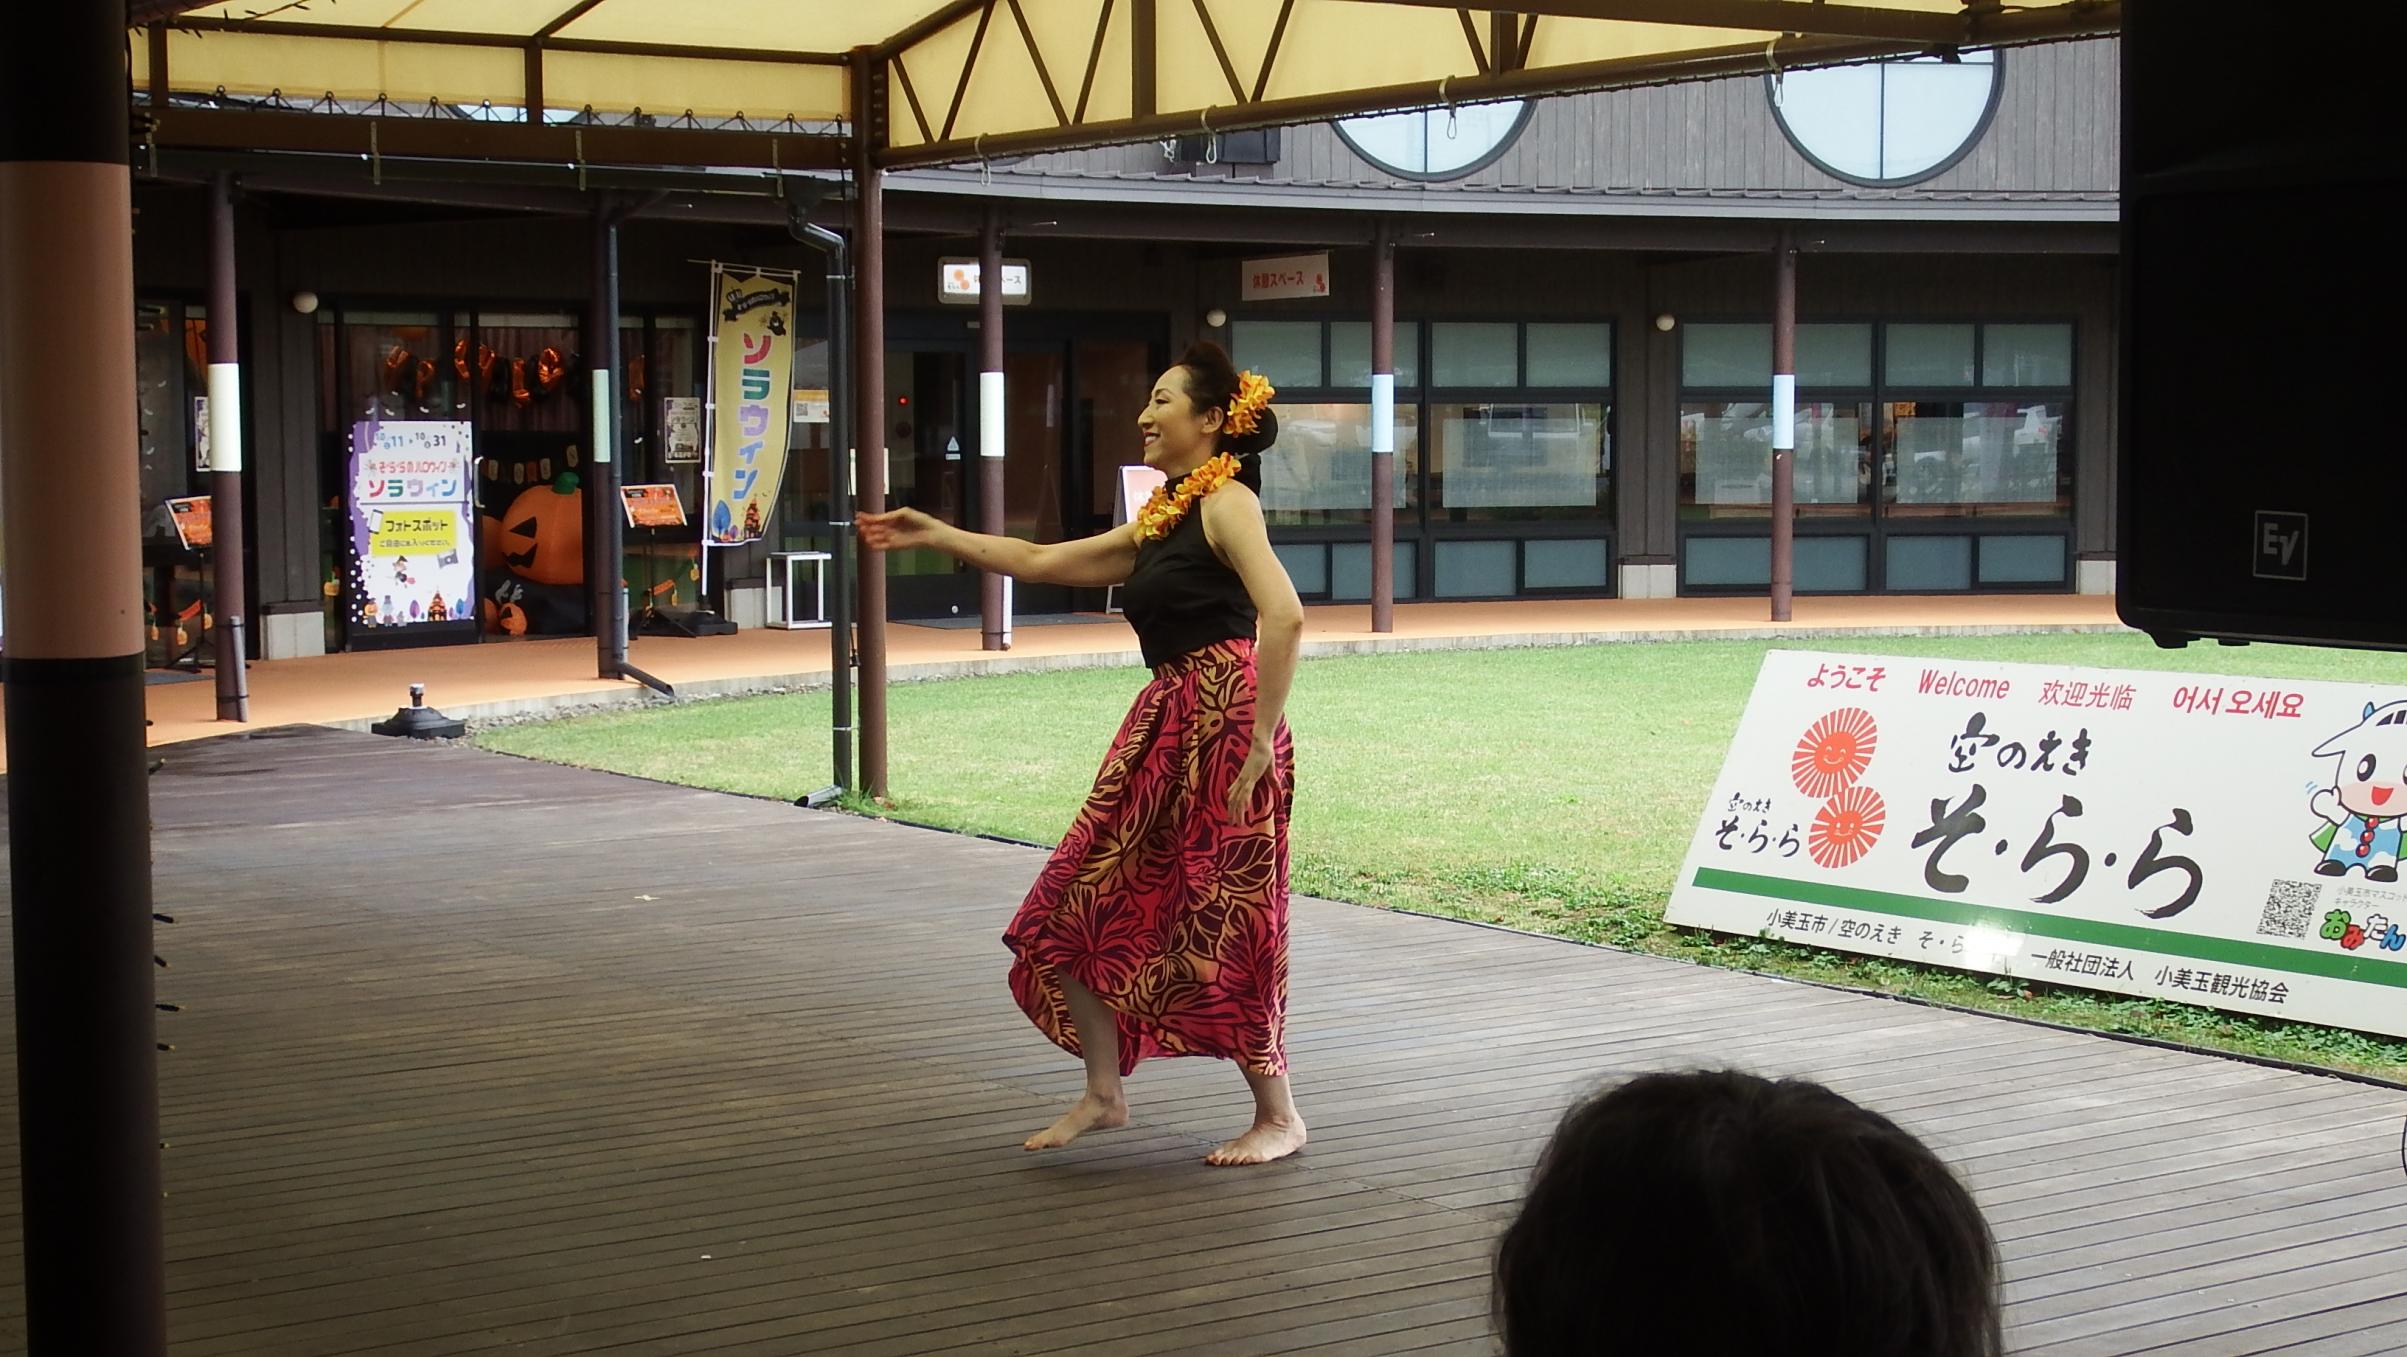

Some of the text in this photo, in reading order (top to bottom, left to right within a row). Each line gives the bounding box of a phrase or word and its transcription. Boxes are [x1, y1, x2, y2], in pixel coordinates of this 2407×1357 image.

[733, 332, 772, 500] ソラウィン
[368, 479, 457, 497] ソラウィン
[385, 517, 448, 532] フォトスポット
[1807, 663, 1887, 692] ようこそ
[1918, 669, 2010, 699] Welcome
[2038, 679, 2137, 711] 欢迎光临
[2172, 686, 2304, 719] 어서 오세요
[1948, 711, 2092, 777] 空のえき
[1728, 792, 1771, 813] 空のえき
[1715, 815, 1800, 857] そ・ら・ら
[1911, 783, 2203, 920] そ・ら・ら
[2319, 909, 2407, 951] おみたん
[2031, 947, 2290, 1004] 一般社団法人 小美玉観光協会
